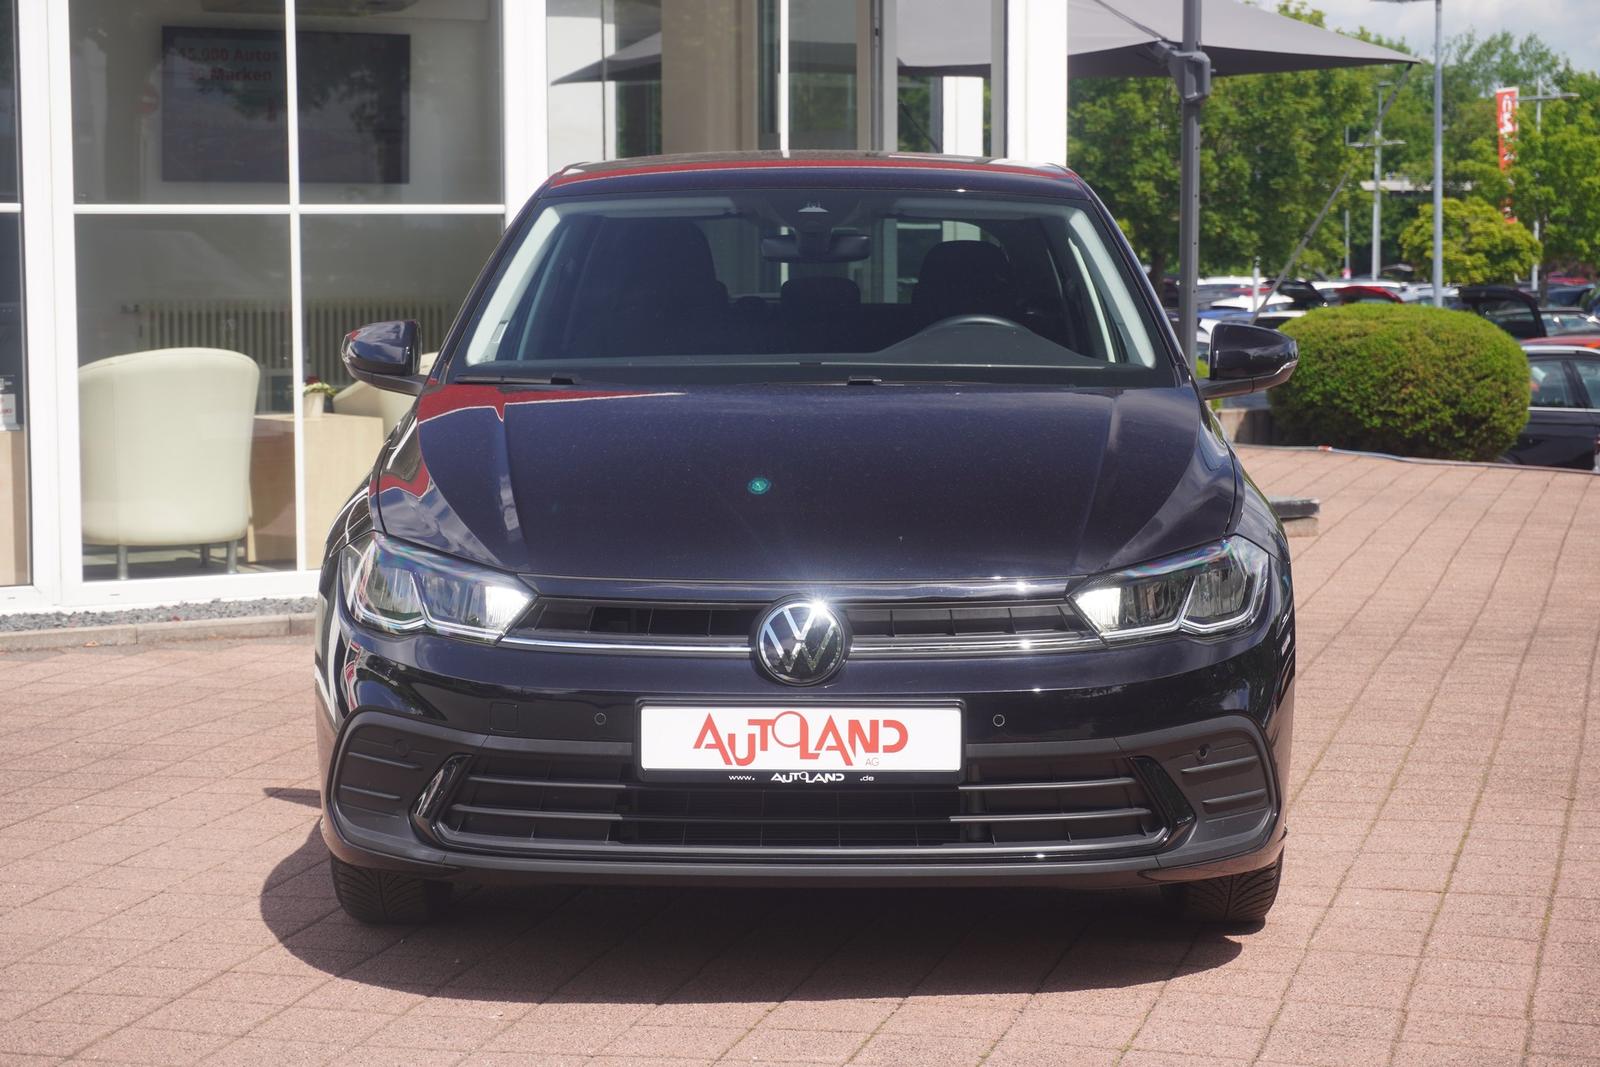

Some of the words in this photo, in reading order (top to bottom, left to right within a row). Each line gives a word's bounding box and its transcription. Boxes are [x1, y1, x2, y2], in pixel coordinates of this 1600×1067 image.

[233, 48, 280, 62] Autos
[210, 67, 273, 81] Marken
[693, 710, 908, 767] AUTOLAND
[865, 757, 880, 767] AG
[728, 774, 756, 782] www.
[770, 771, 845, 784] AUTOLAND
[859, 774, 875, 782] .de
